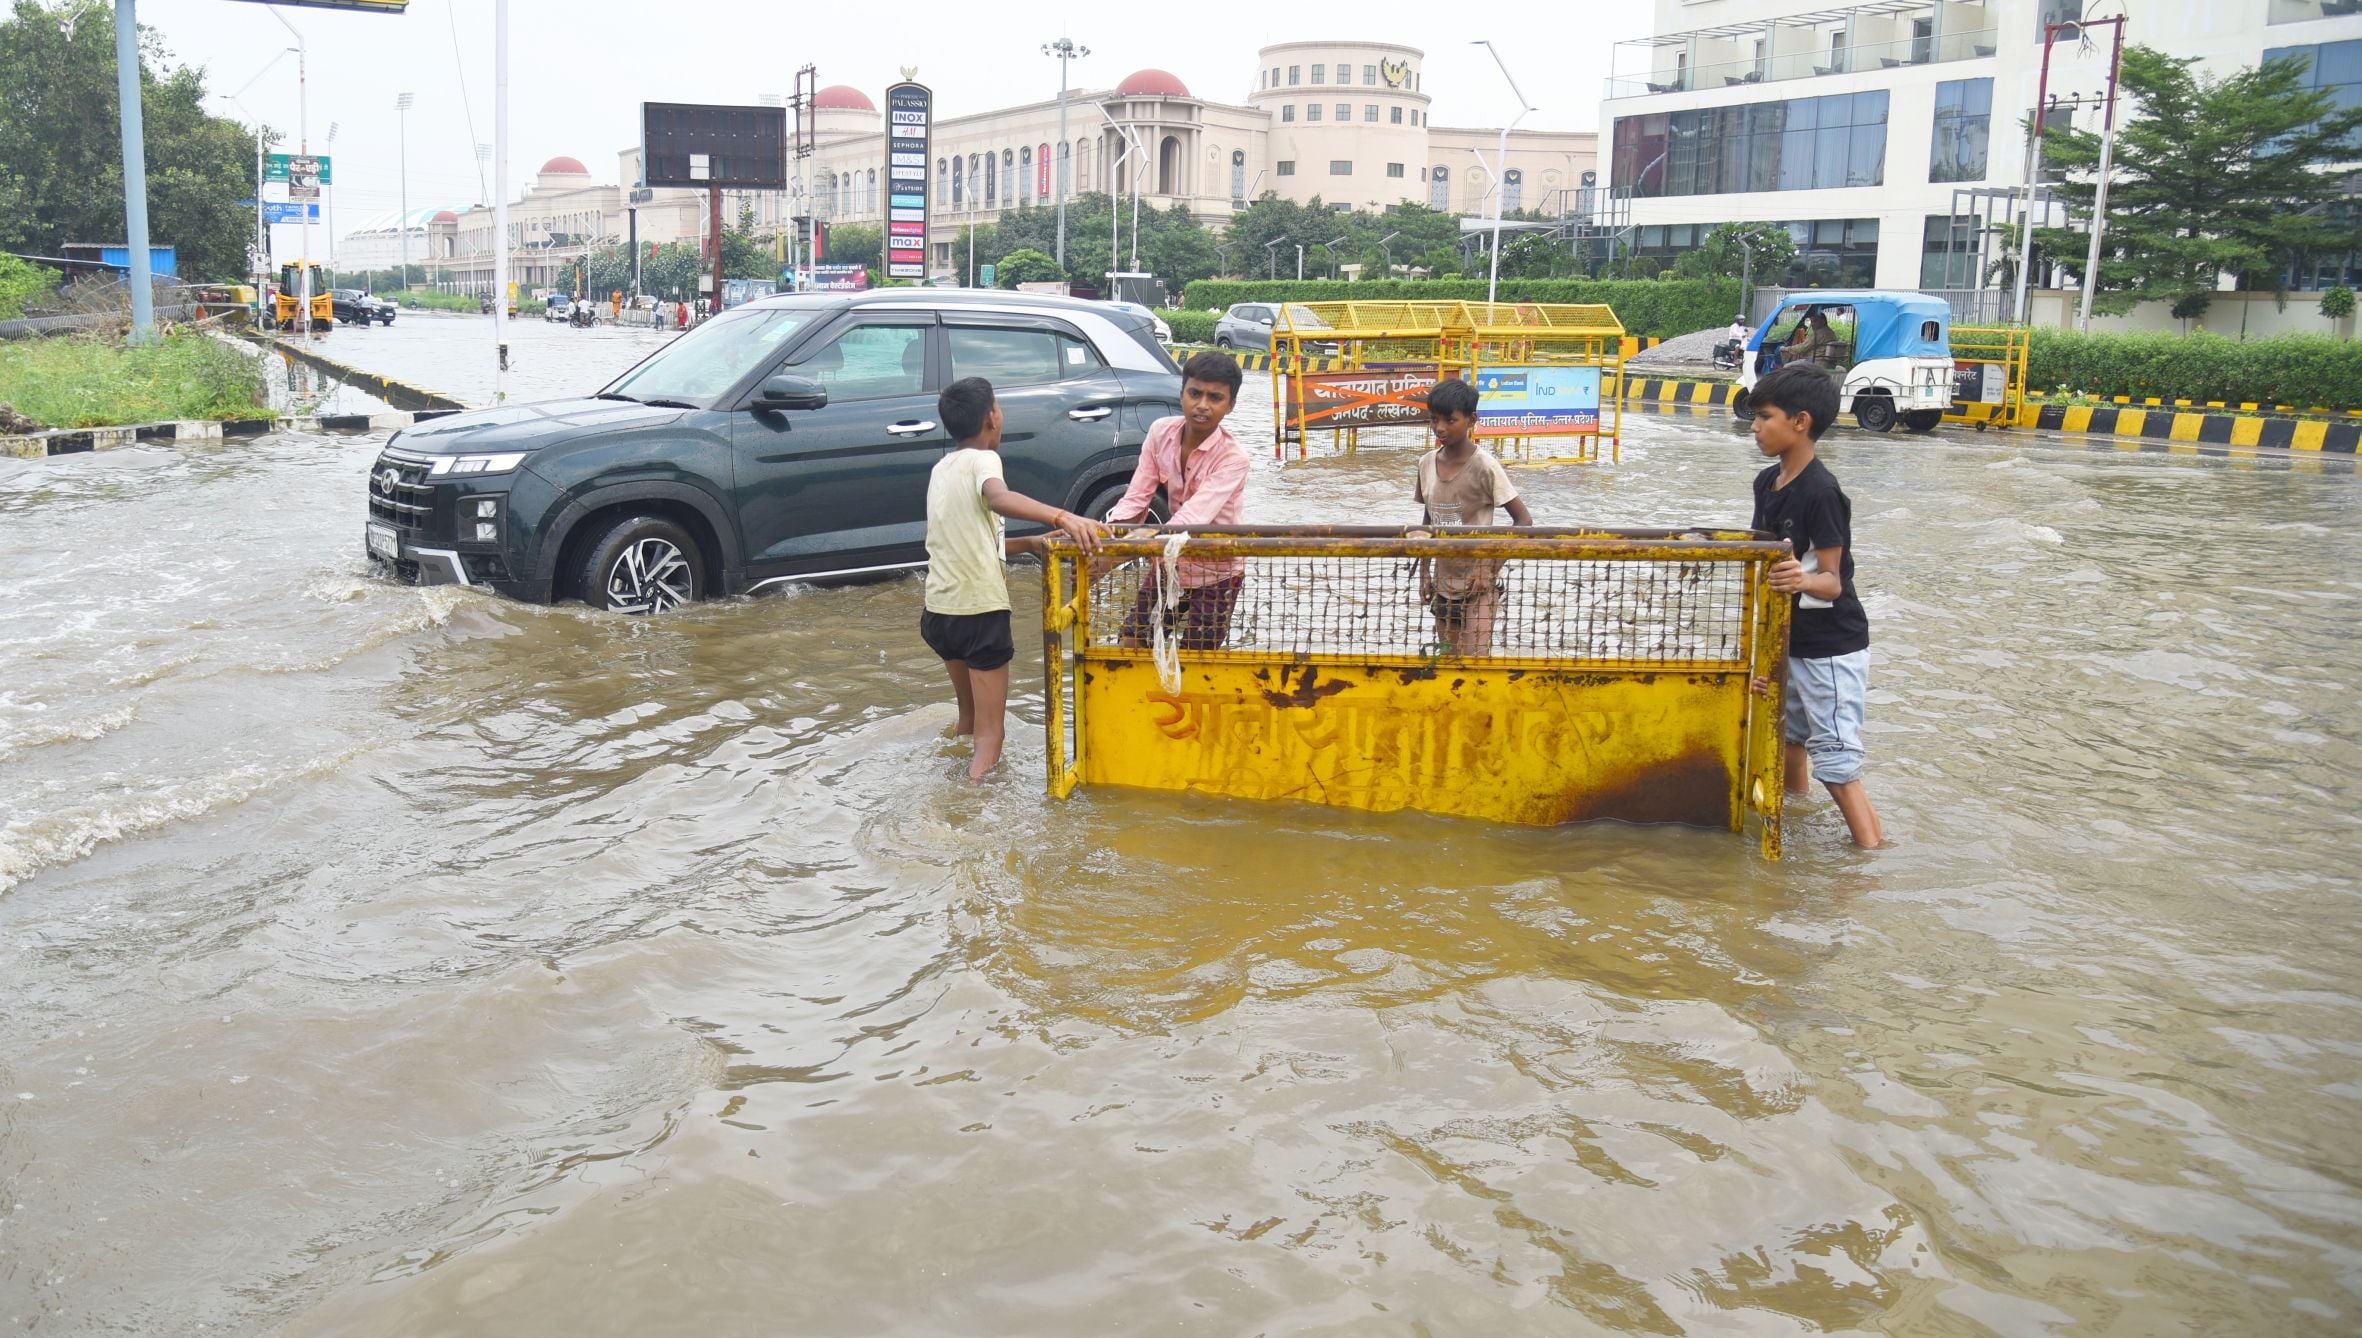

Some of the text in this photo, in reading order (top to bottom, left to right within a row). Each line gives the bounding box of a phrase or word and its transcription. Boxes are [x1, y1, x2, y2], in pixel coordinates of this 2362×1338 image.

[894, 112, 923, 122] INOX
[892, 238, 921, 247] max
[1479, 416, 1518, 427] यातायात
